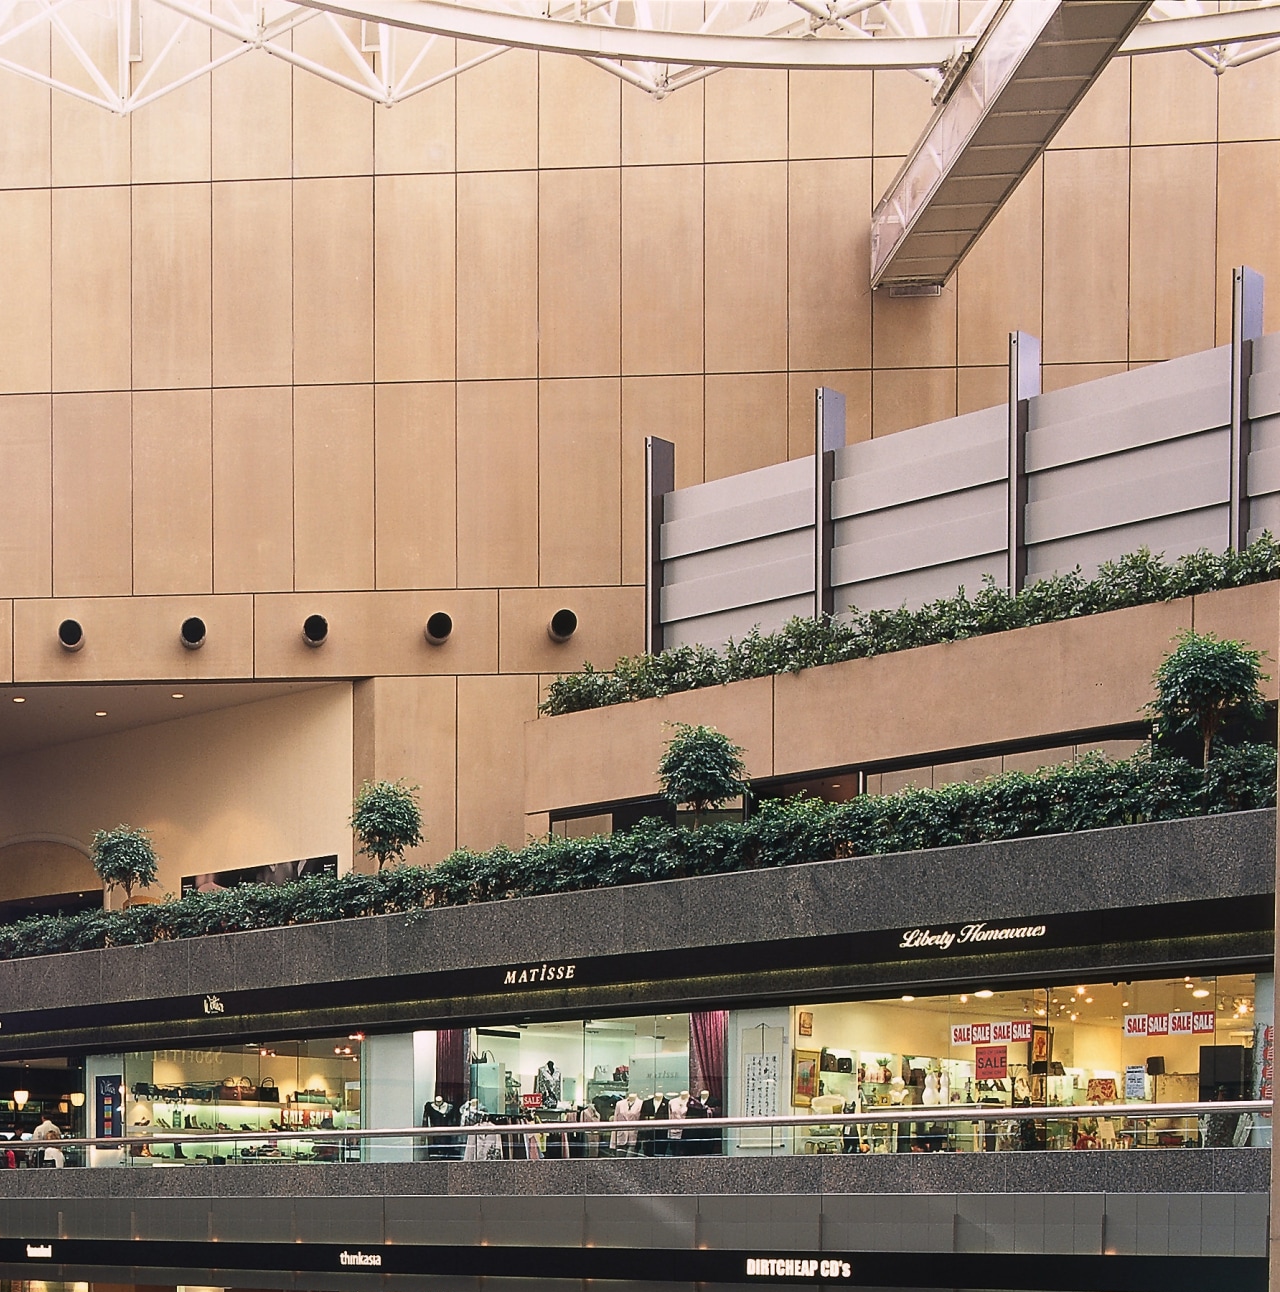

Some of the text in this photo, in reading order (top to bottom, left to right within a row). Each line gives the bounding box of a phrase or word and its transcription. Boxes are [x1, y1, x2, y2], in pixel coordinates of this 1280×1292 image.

[899, 922, 1046, 949] Liberty Homewares
[953, 1023, 1031, 1042] SALE SALE SALE SALE
[1128, 1013, 1214, 1033] SALE SALE SALE SALE
[978, 1057, 1007, 1068] SALE
[523, 1096, 541, 1105] SALE
[283, 1110, 304, 1124] SALE
[746, 1259, 851, 1278] DIRTCHEAP CD's
